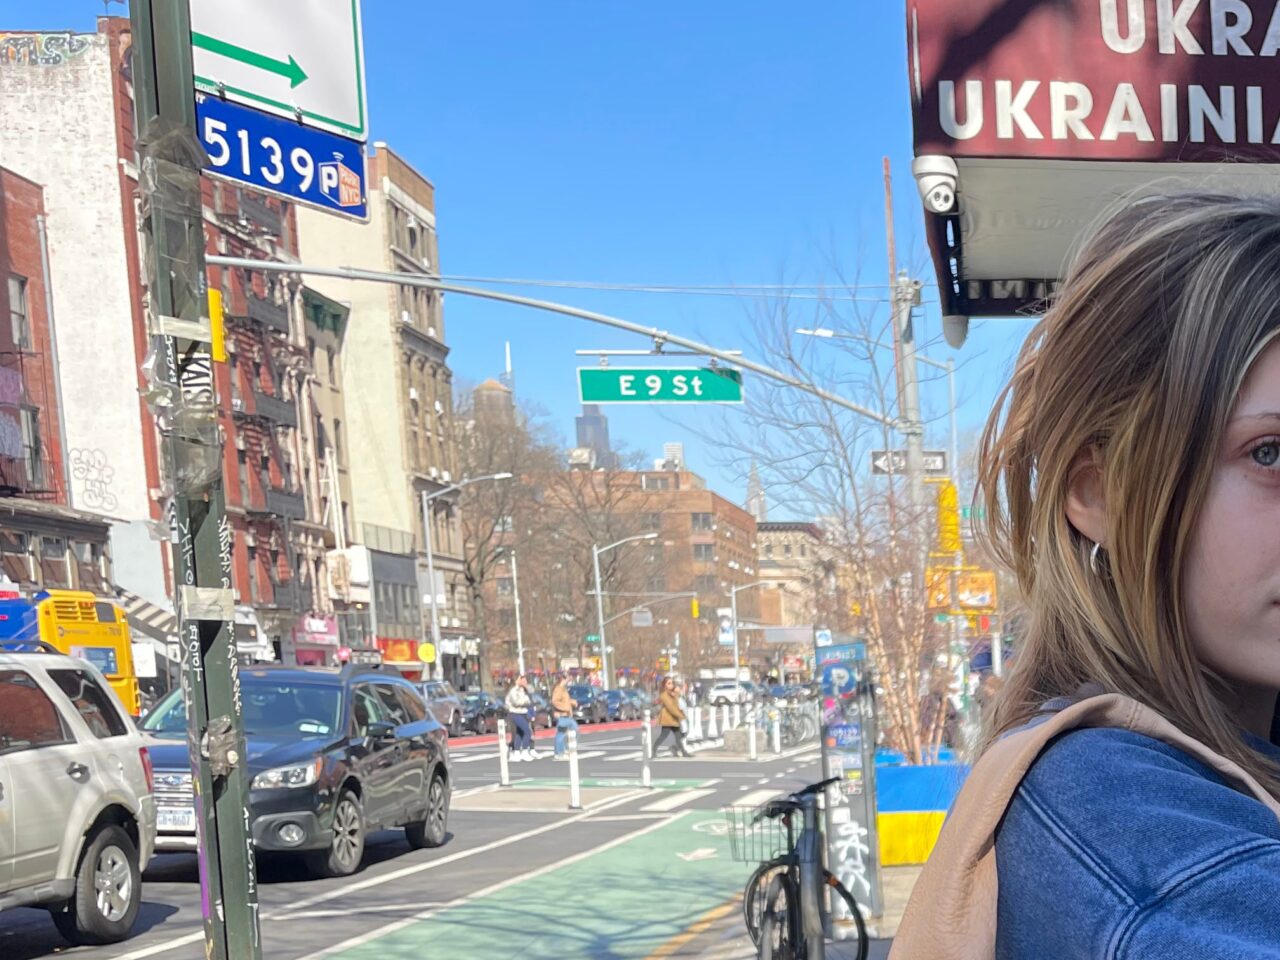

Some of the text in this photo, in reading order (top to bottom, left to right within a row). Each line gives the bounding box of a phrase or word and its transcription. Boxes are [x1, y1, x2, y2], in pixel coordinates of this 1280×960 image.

[204, 116, 314, 193] 5139
[619, 375, 704, 396] E 9 St
